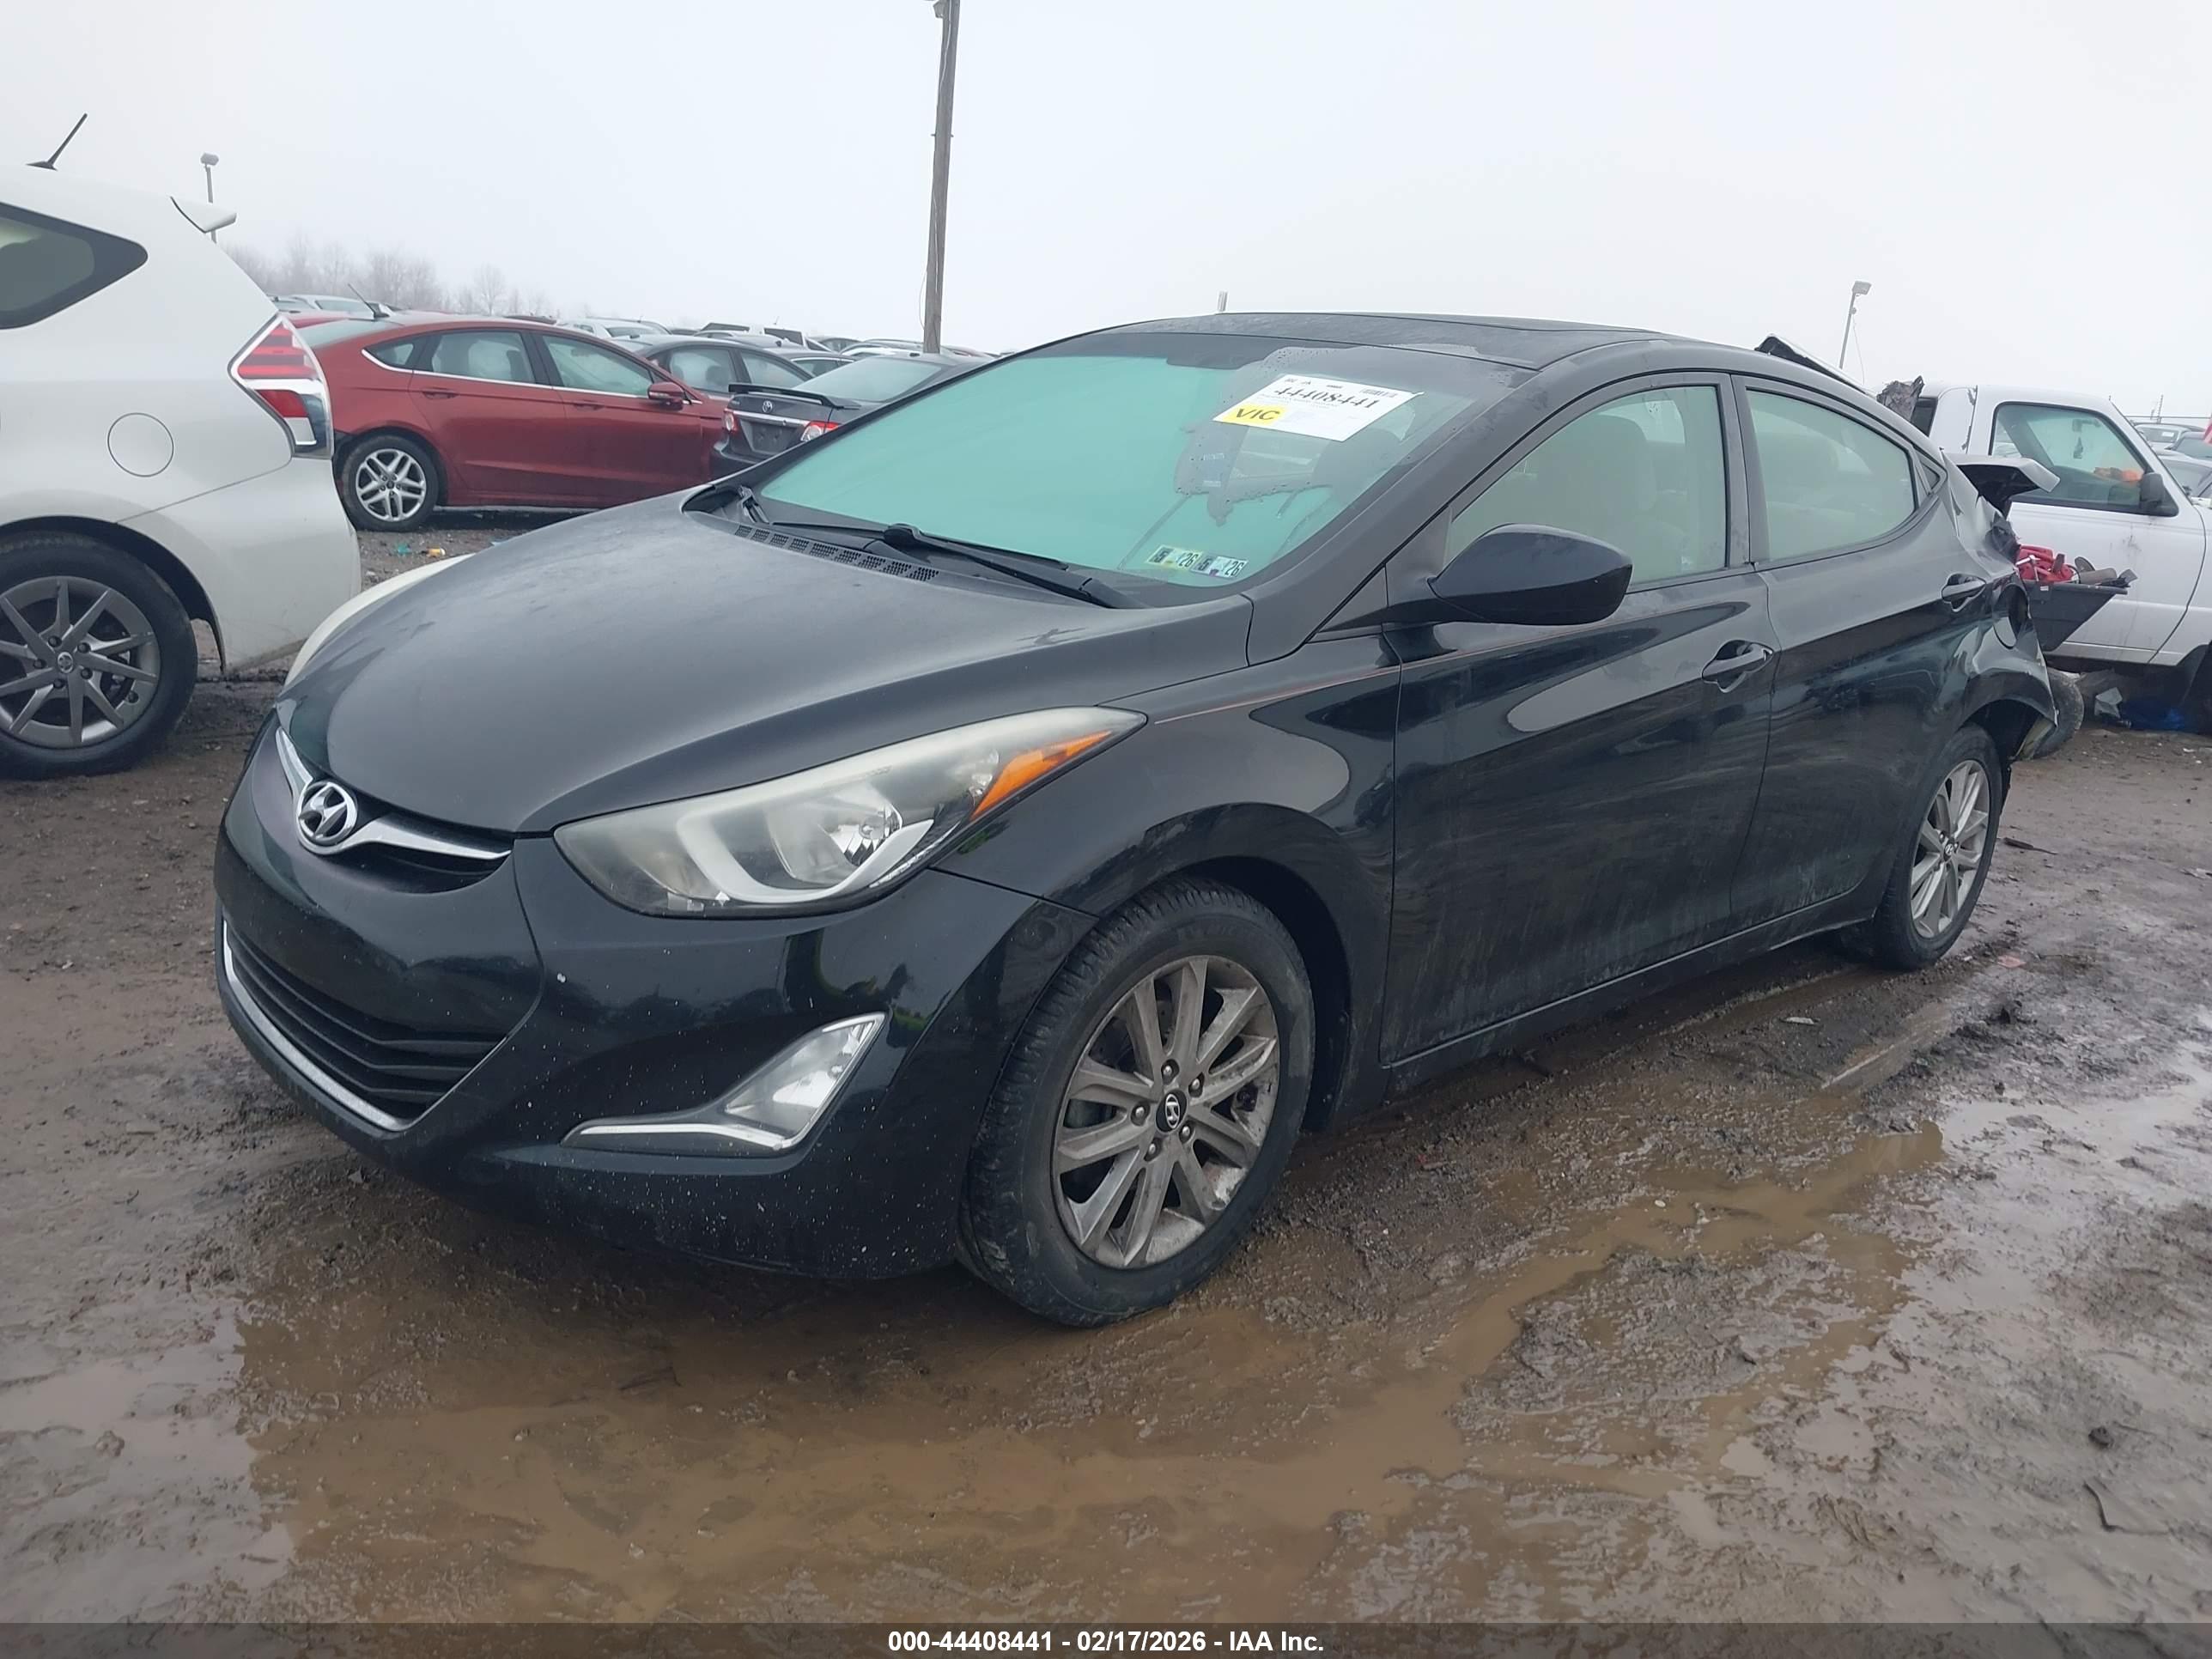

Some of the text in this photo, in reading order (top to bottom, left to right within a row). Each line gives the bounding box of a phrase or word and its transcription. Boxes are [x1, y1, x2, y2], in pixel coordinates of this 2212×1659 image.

[1274, 386, 1379, 408] 44408441
[1235, 408, 1280, 421] VIC
[1180, 552, 1199, 567] 26
[1225, 561, 1244, 576] 26
